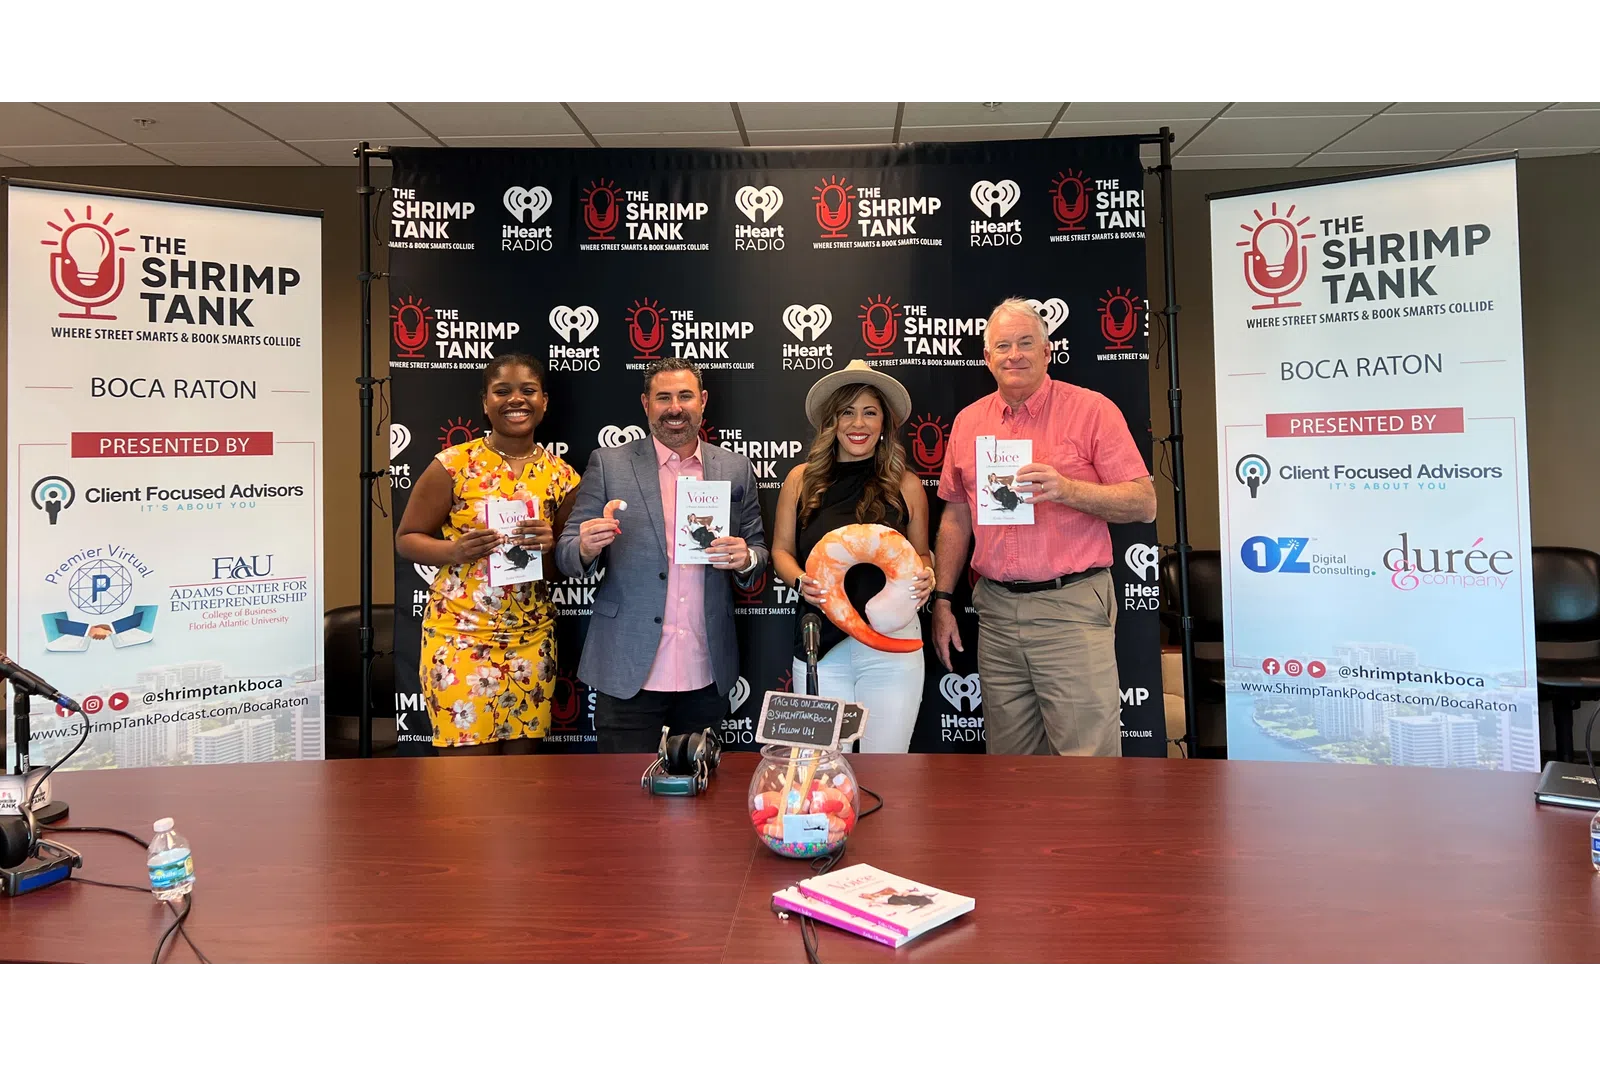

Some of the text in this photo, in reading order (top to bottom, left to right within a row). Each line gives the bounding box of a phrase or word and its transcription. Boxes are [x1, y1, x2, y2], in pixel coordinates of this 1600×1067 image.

[857, 188, 881, 198] THE
[1095, 179, 1119, 190] THE
[392, 188, 415, 199] THE
[625, 191, 649, 201] THE
[392, 200, 475, 220] SHRIMP
[626, 203, 709, 221] SHRIMP
[857, 197, 941, 218] SHRIMP
[391, 220, 449, 239] TANK
[502, 225, 552, 239] iHeart
[625, 223, 684, 241] TANK
[735, 224, 784, 238] iHeart
[858, 217, 916, 237] TANK
[970, 219, 1022, 234] iHeart
[1320, 216, 1364, 236] THE
[140, 235, 187, 255] THE
[502, 239, 553, 251] RADIO
[735, 239, 785, 250] RADIO
[897, 238, 920, 246] SMARTS
[920, 238, 942, 246] COLLIDE
[970, 234, 1023, 247] RADIO
[1050, 235, 1070, 243] WHERE
[1070, 234, 1091, 242] STREET
[1091, 233, 1114, 241] SMARTS
[1322, 223, 1491, 269] SHRIMP
[140, 257, 301, 295] SHRIMP
[1322, 265, 1438, 304] TANK
[140, 293, 254, 327] TANK
[435, 309, 459, 320] THE
[670, 310, 694, 321] THE
[903, 305, 927, 316] THE
[1246, 300, 1494, 329] WHERE STREET SMARTS & BOOK SMARTS COLLIDE
[435, 321, 520, 340] SHRIMP
[671, 322, 754, 340] SHRIMP
[903, 317, 988, 336] SHRIMP
[51, 328, 301, 347] WHERE STREET SMARTS & BOOK SMARTS COLLIDE
[435, 341, 494, 359] TANK
[549, 345, 600, 359] iHeart
[671, 342, 730, 359] TANK
[783, 344, 833, 358] iHeart
[903, 337, 962, 356] TANK
[549, 359, 600, 372] RADIO
[733, 362, 755, 370] COLLIDE
[782, 358, 834, 370] RADIO
[879, 359, 898, 367] STREET
[899, 358, 921, 366] SMARTS
[1280, 353, 1443, 381] BOCA RATON
[91, 378, 257, 400] BOCA RATON
[1290, 415, 1437, 434] PRESENTED BY
[719, 429, 742, 440] THE
[100, 437, 250, 454] PRESENTED BY
[1279, 463, 1503, 480] Client Focused Advisors
[85, 484, 304, 503] Client Focused Advisors
[1418, 482, 1447, 490] YOU
[687, 492, 719, 503] Voice
[141, 501, 256, 512] IT'S ABOUT YOU
[1312, 554, 1347, 566] Digital
[1382, 532, 1514, 576] durée
[44, 544, 155, 585] Premier Virtual
[212, 554, 274, 580] FAU
[1391, 559, 1507, 591] & company
[170, 580, 307, 600] ADAMS CENTER FOR
[170, 592, 307, 613] ENTREPRENEURSHIP
[202, 606, 277, 620] College of Business
[188, 615, 289, 631] Florida Atlantic University
[1338, 665, 1485, 688] @shrimptankboca
[142, 677, 283, 705] @shrimptankboca
[1240, 681, 1518, 713] www.ShrimpTankPodcast.com/BocaRaton
[771, 697, 788, 706] TAG
[790, 699, 798, 708] US
[800, 700, 810, 708] ON
